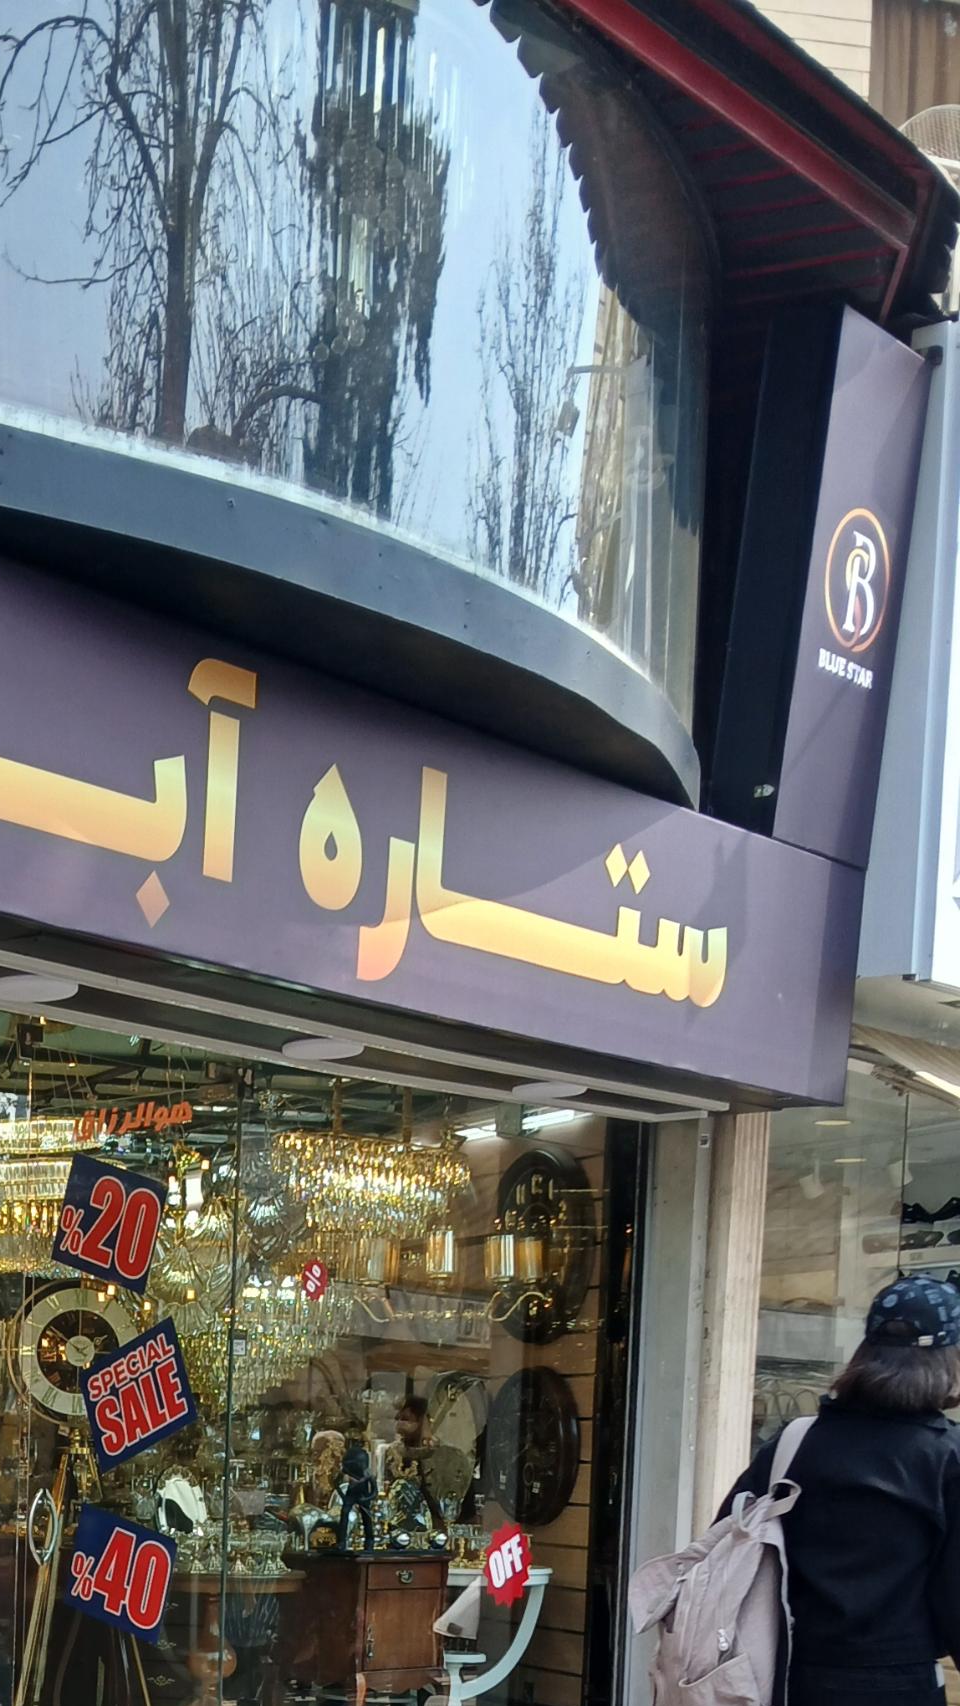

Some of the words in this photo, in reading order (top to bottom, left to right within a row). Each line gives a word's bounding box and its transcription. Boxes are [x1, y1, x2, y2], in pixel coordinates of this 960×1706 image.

[819, 647, 847, 677] BLUE
[846, 661, 874, 689] STAR
[299, 763, 729, 1008] ستاره
[60, 1174, 162, 1280] %20
[87, 1332, 175, 1402] SPECIAL
[95, 1357, 189, 1457] SALE
[71, 1528, 172, 1631] %40
[488, 1534, 523, 1589] OFF
